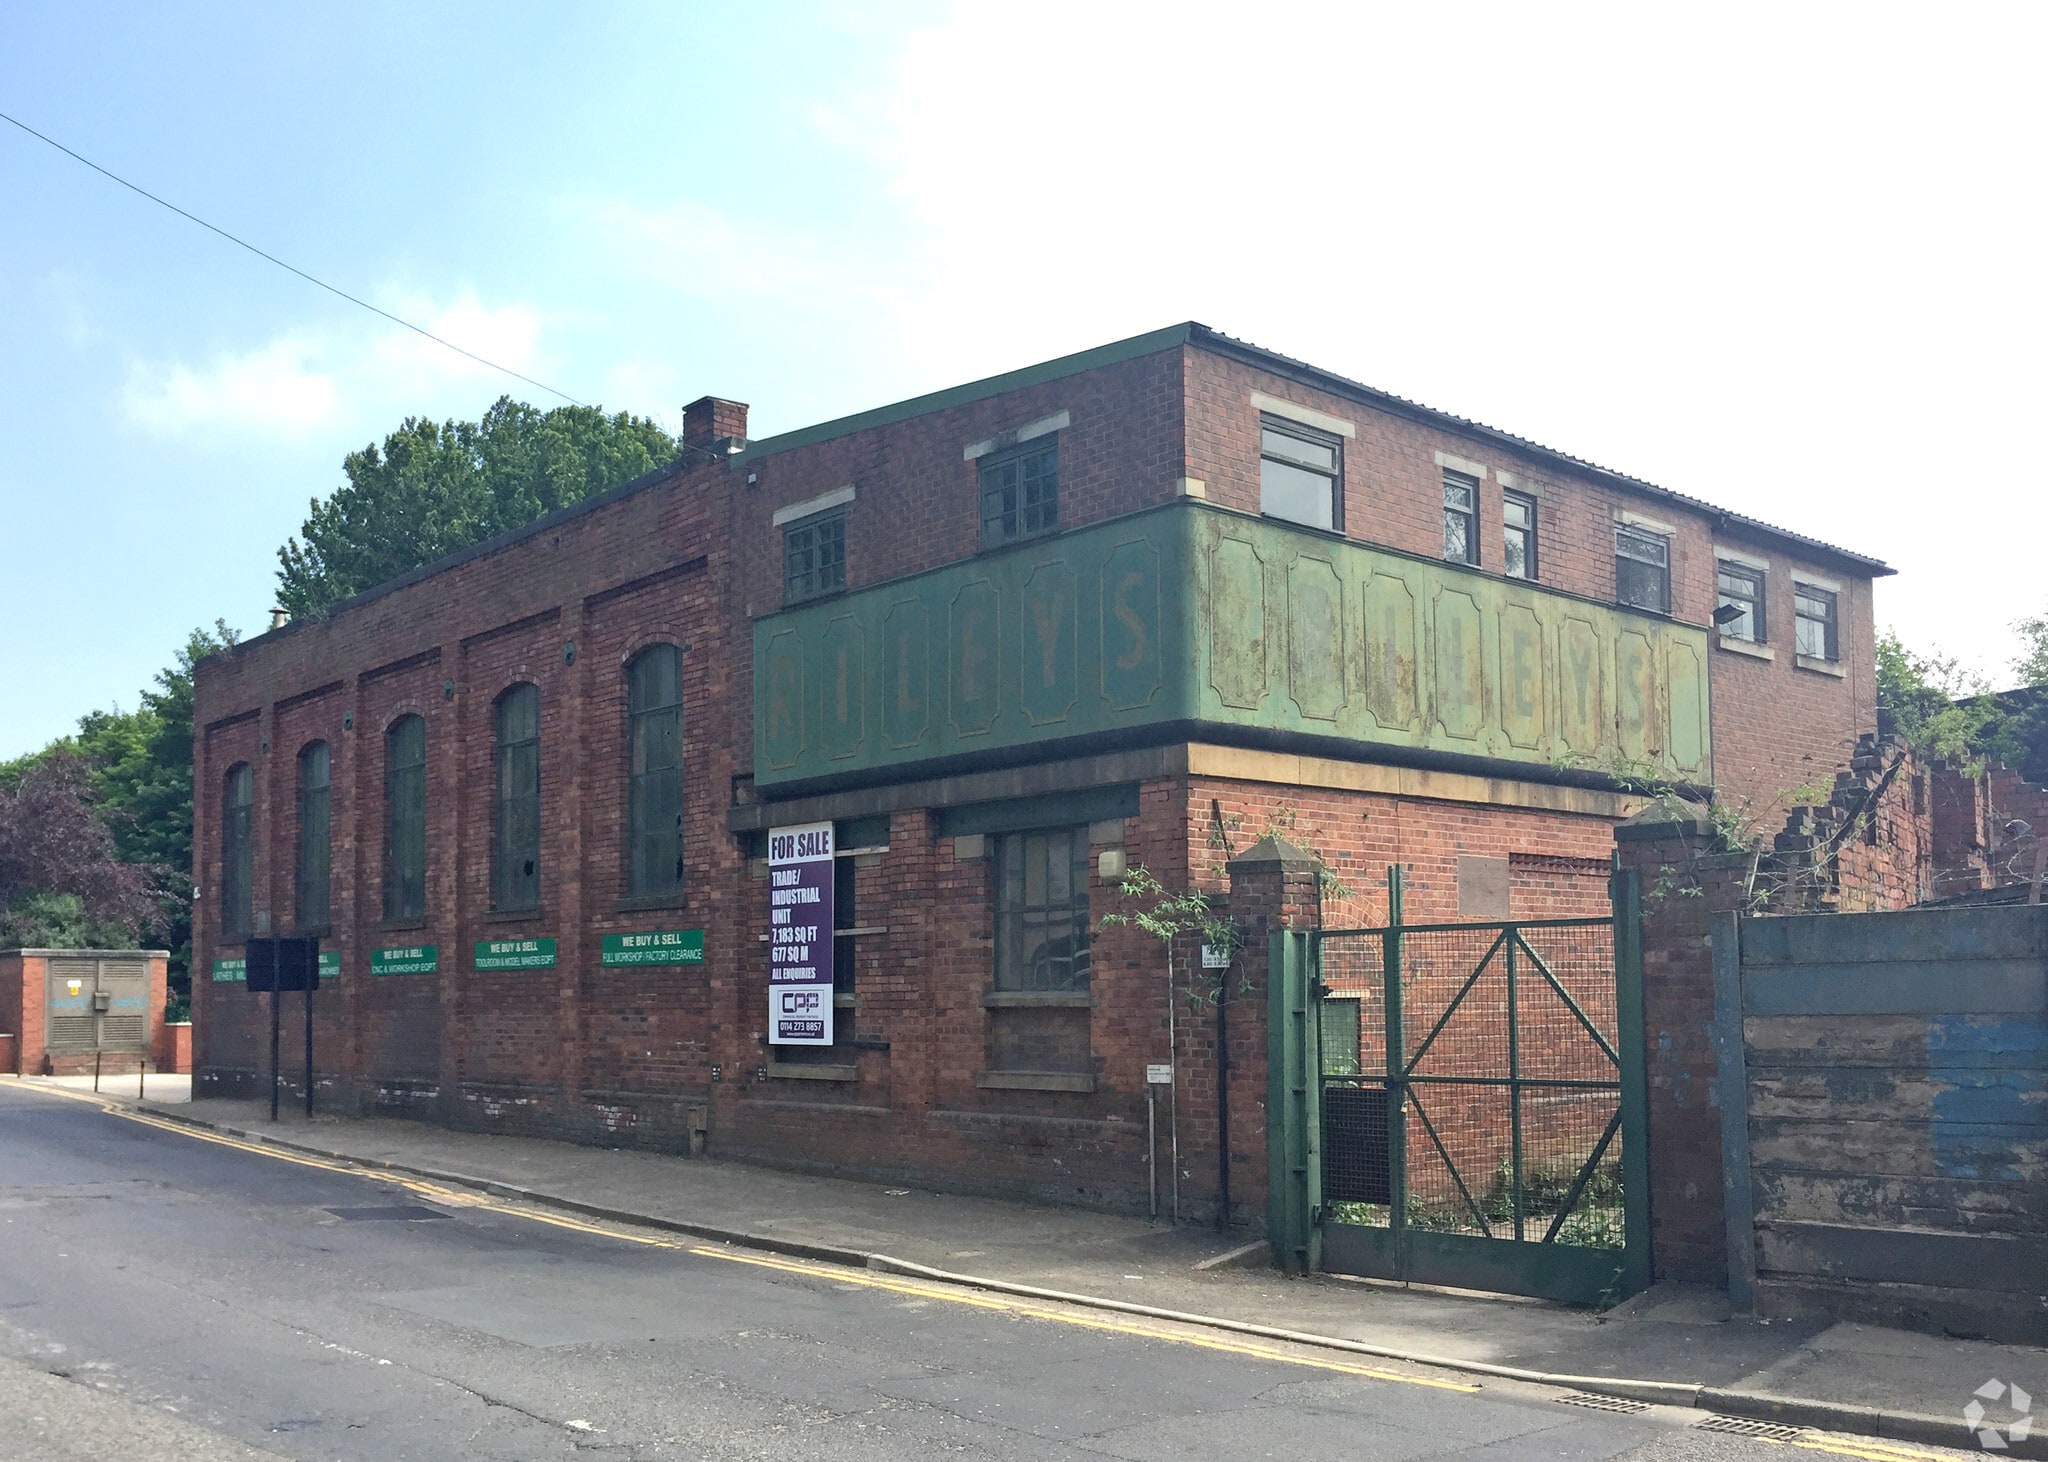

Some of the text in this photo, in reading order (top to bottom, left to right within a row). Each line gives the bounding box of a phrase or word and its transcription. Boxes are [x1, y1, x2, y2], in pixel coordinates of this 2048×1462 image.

[769, 571, 1148, 739] RILEYS
[771, 831, 830, 860] FOR SALE
[772, 869, 801, 887] TRADE/
[772, 887, 821, 906] INDUSTRIAL
[772, 908, 792, 925] UNIT
[622, 933, 682, 947] WE BUY & SELL
[772, 926, 818, 945] 7,183 SQ FT
[410, 948, 423, 957] SELL
[490, 941, 538, 953] WE BUY & SELL
[772, 945, 809, 963] 677 SQ M
[603, 952, 615, 963] FULL
[615, 951, 643, 962] WORKSHOP
[646, 950, 669, 961] FACTORY
[670, 948, 702, 960] CLEARANCE
[388, 963, 419, 973] WORKSHOP
[772, 967, 816, 980] ALL ENQUIRIES
[779, 1022, 822, 1031] 0114 273 8857
